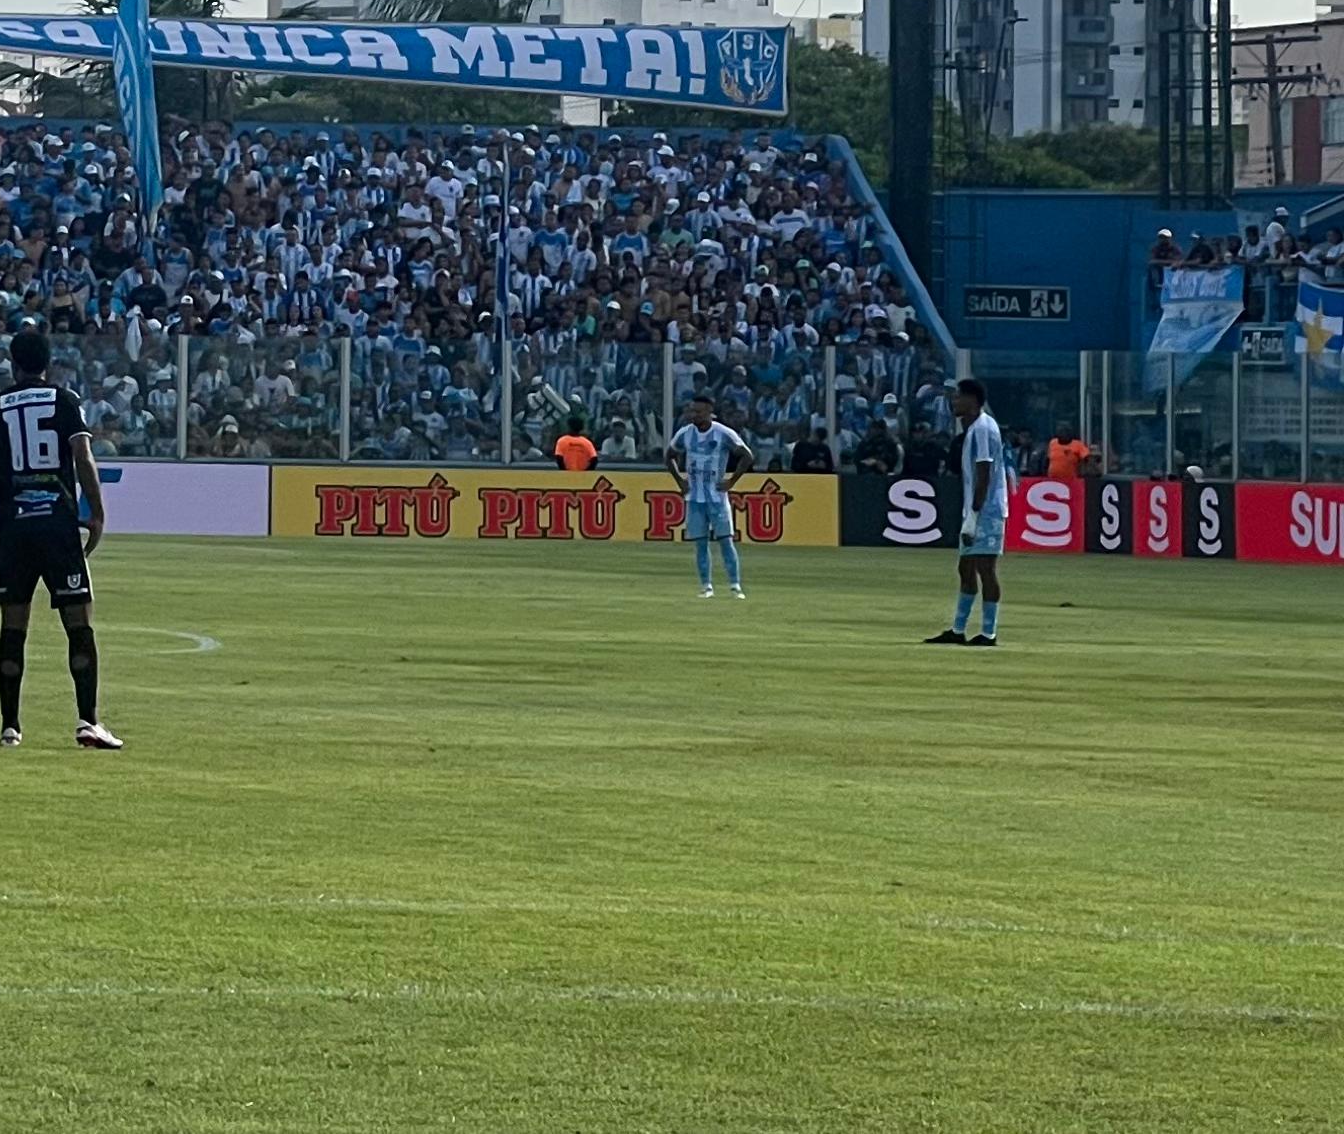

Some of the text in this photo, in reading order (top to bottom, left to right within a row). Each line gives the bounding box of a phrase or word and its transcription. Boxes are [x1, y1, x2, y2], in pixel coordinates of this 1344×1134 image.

[417, 27, 707, 95] META!
[967, 291, 1021, 313] SAÍDA
[2, 404, 60, 472] 16
[315, 474, 454, 537] PITÚ
[479, 475, 620, 540] PITÚ
[644, 478, 788, 542] PÚ
[1289, 490, 1343, 556] SU
